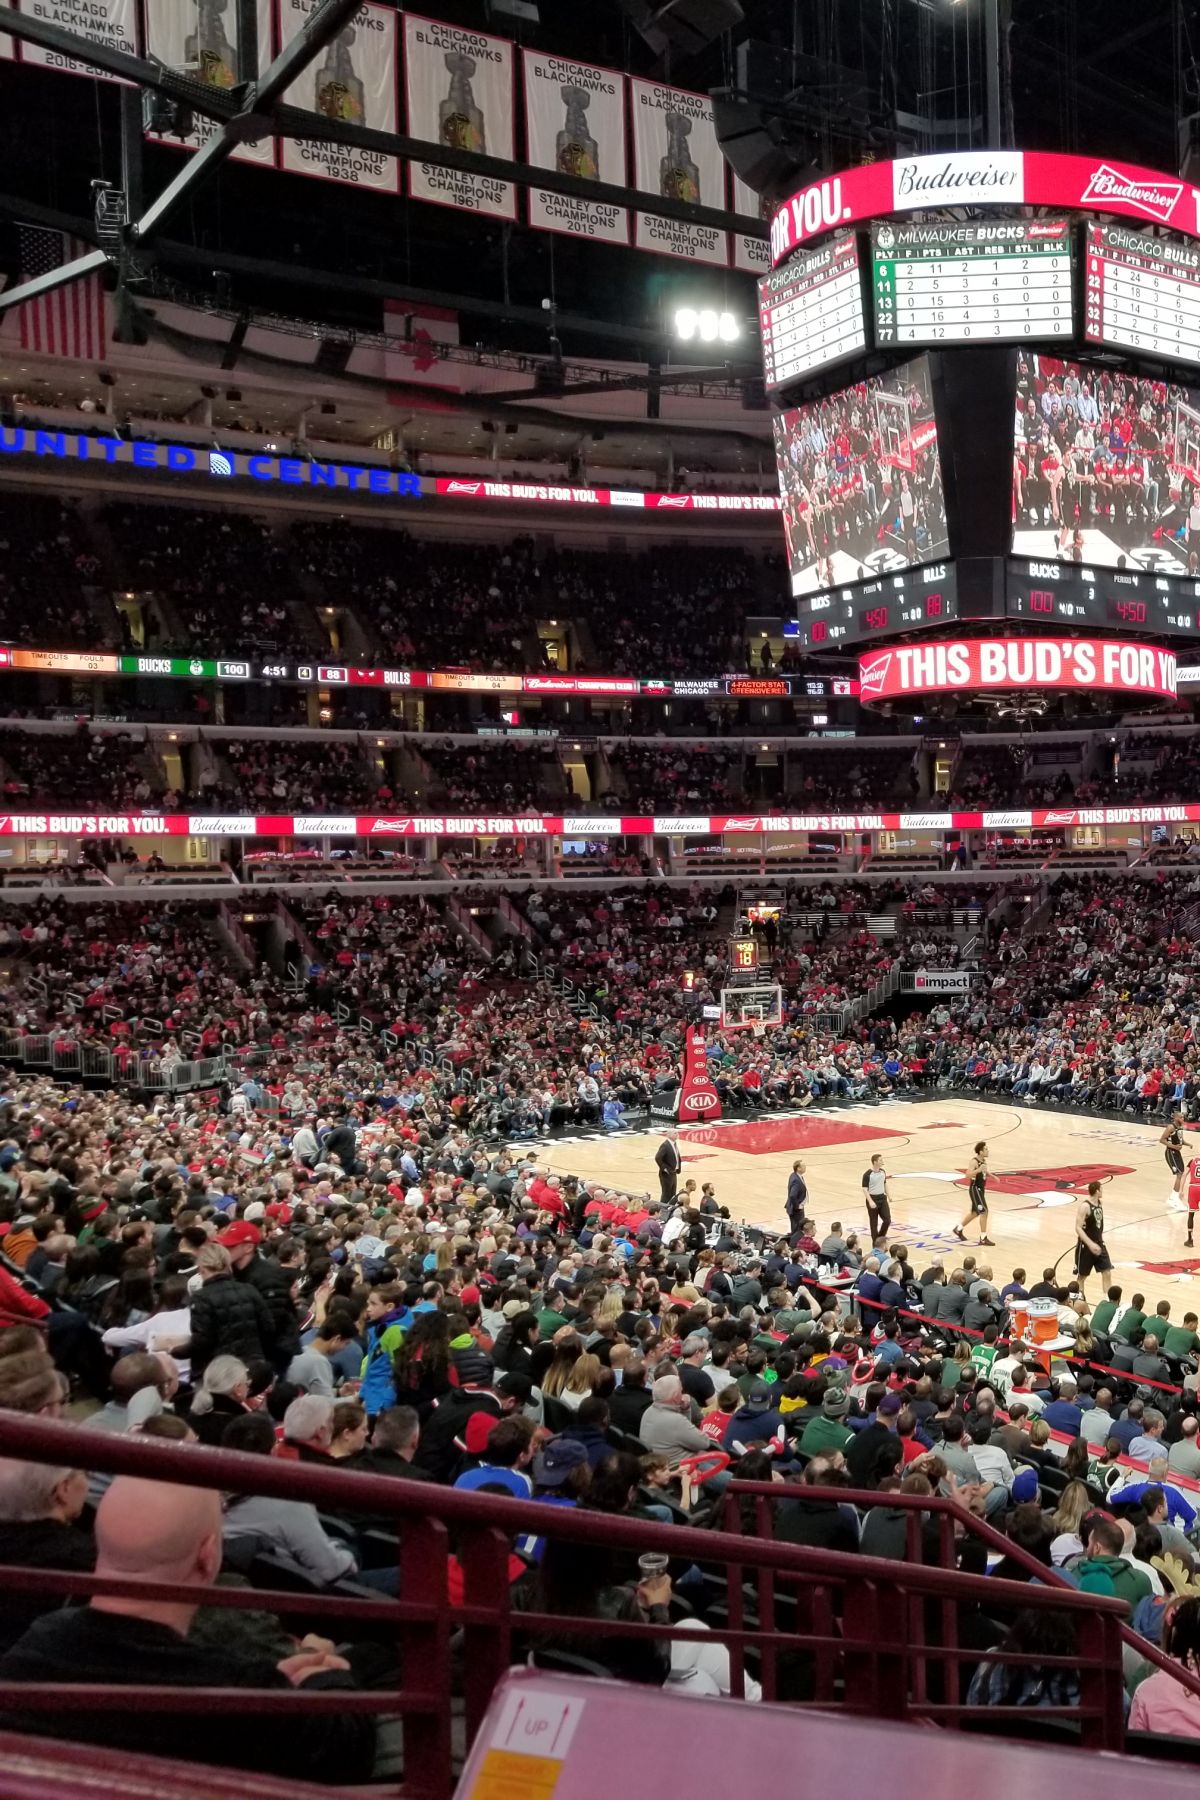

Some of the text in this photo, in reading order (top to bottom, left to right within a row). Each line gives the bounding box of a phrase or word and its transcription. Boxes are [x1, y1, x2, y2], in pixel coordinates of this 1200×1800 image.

[33, 4, 124, 36] BLACKHAWKS
[416, 31, 502, 63] BLACKHAWKS
[430, 24, 488, 48] CHICAGO
[534, 65, 615, 95] BLACKHAWKS
[548, 59, 602, 81] CHICAGO
[640, 94, 715, 122] BLACKHAWKS
[653, 87, 703, 109] CHICAGO
[301, 149, 383, 175] CHAMPIONS
[359, 150, 388, 165] CUP
[326, 166, 359, 182] 1938
[421, 163, 507, 193] STANLEY CUP
[899, 163, 1018, 195] Budweiser
[428, 177, 502, 204] CHAMPIONS
[452, 194, 480, 209] 1961
[1090, 173, 1176, 208] Budweiser
[539, 193, 620, 218] STANLEY CUP
[545, 205, 615, 228] CHAMPIONS
[792, 178, 851, 239] YOU.
[567, 220, 595, 235] 2015
[644, 216, 719, 240] STANLEY CUP
[898, 226, 1024, 244] MILWAUKEE BUCKS
[649, 228, 715, 250] CHAMPIONS
[670, 243, 695, 256] 2013
[1109, 232, 1198, 266] CHICAGO BULLS
[876, 251, 894, 259] PLY
[923, 249, 942, 257] PTS
[955, 248, 974, 256] AST
[1015, 244, 1033, 252] STL
[1044, 243, 1064, 251] BLK
[877, 280, 891, 292] 11
[878, 297, 944, 309] 13 15
[878, 312, 944, 324] 22 16
[878, 328, 945, 341] 77 12
[0, 425, 422, 497] UNITED CENTER
[1030, 563, 1060, 580] BUCKS
[1030, 590, 1053, 613] 100
[1116, 601, 1146, 623] 4:50
[31, 652, 69, 661] TIMEOUTS
[896, 642, 971, 689] THIS
[980, 642, 1096, 684] BUD'S
[1104, 645, 1156, 688] FOR
[138, 658, 411, 685] BUCKS 100 4:51 88 BULLS
[9, 817, 169, 832] THIS BUD'S FOR YOU.
[412, 819, 547, 833] THIS BUD'S FOR YOU.
[761, 816, 885, 830] THIS BUD'S FOR YOU.
[1078, 807, 1188, 823] THIS BUD'S FOR YOU.
[739, 952, 752, 966] 18
[925, 975, 968, 990] impact
[689, 1095, 713, 1107] KIA
[524, 1719, 549, 1735] UP
